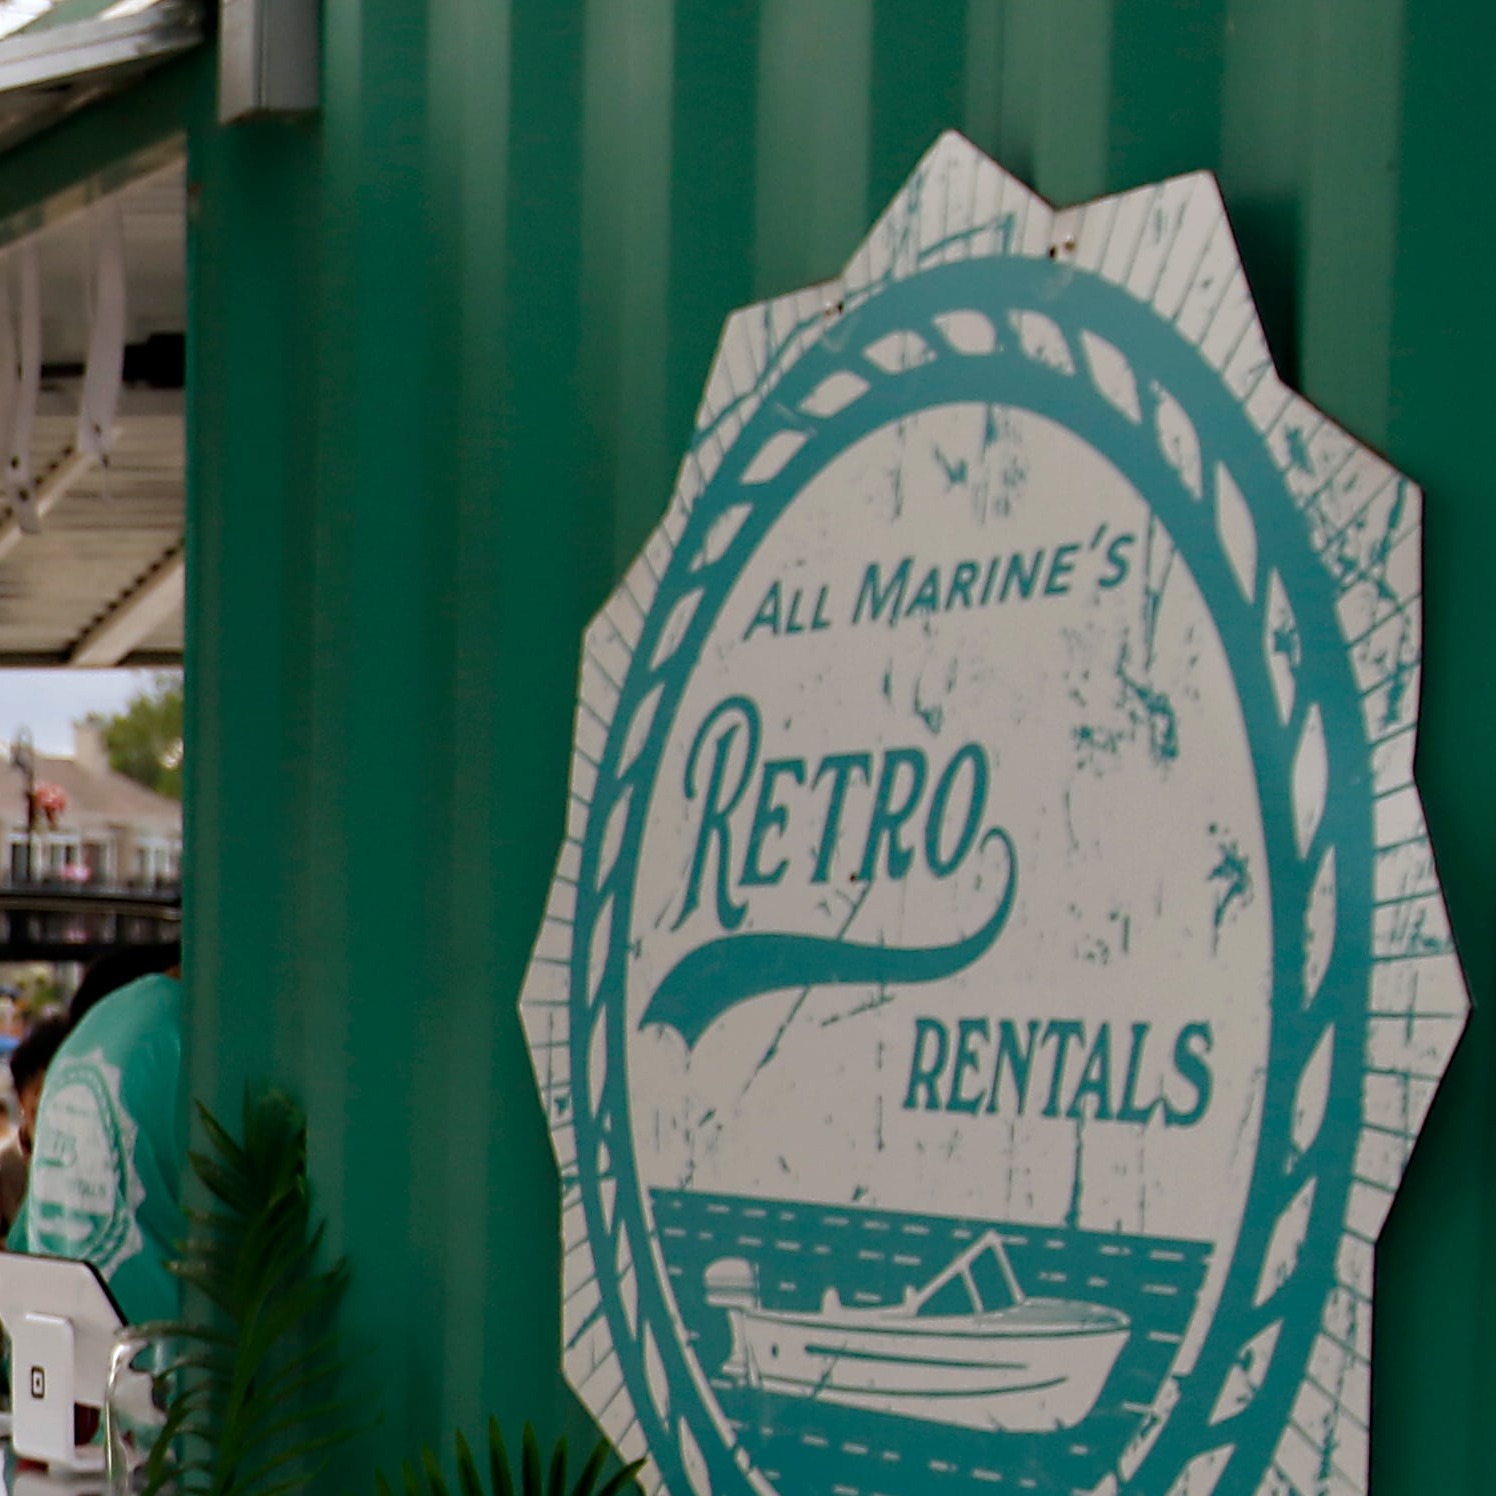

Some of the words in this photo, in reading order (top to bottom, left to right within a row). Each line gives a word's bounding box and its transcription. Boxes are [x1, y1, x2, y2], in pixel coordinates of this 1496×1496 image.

[743, 579, 831, 641] ALL
[852, 522, 1137, 628] MARINE'S
[670, 694, 991, 931] RETRO
[902, 1016, 1215, 1127] RENTALS
